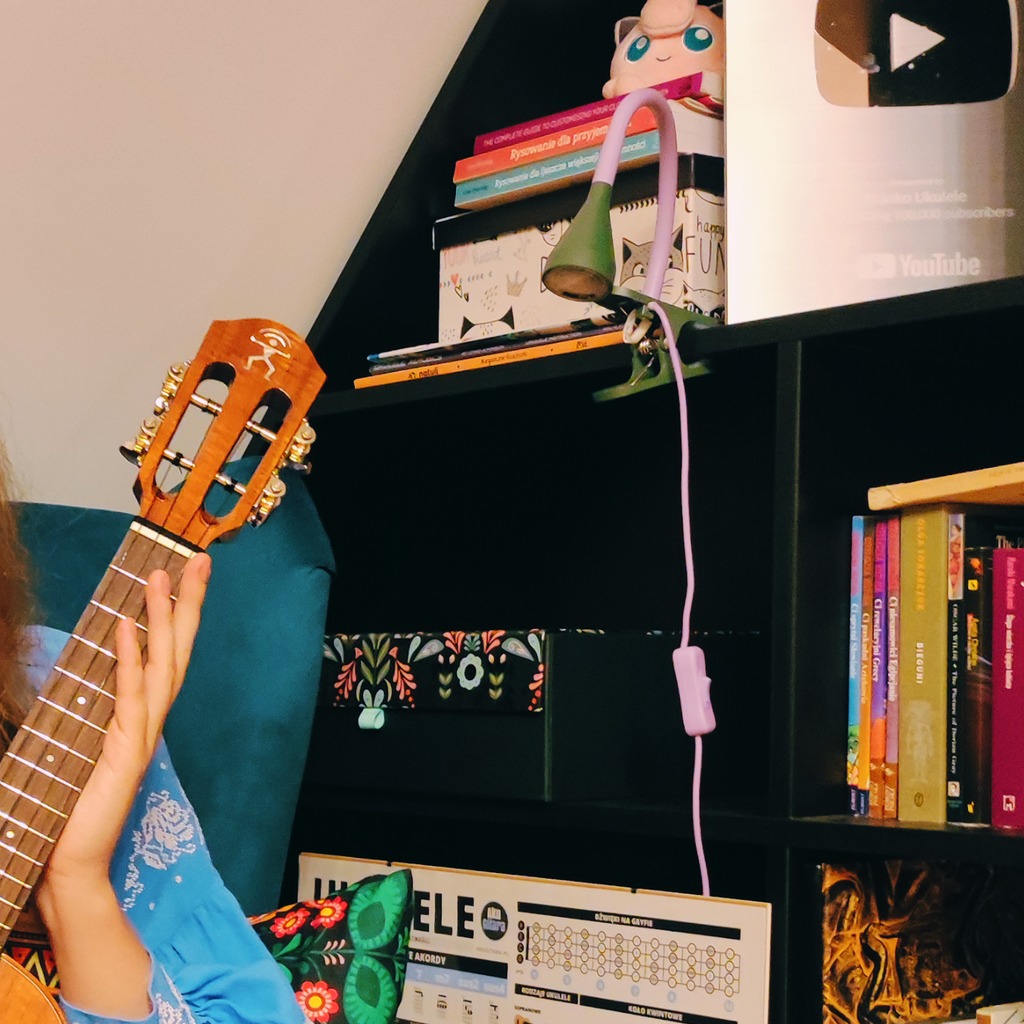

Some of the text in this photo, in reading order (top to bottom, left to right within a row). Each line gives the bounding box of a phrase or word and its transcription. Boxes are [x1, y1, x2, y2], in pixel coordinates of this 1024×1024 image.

[510, 139, 556, 162] Rysowanie
[557, 133, 571, 147] dla
[914, 189, 967, 204] Ukulele
[945, 206, 1016, 219] subscribers
[697, 215, 725, 242] happy
[899, 252, 981, 278] YouTube
[916, 642, 924, 685] BIEGUNI
[415, 951, 447, 966] AKORDY
